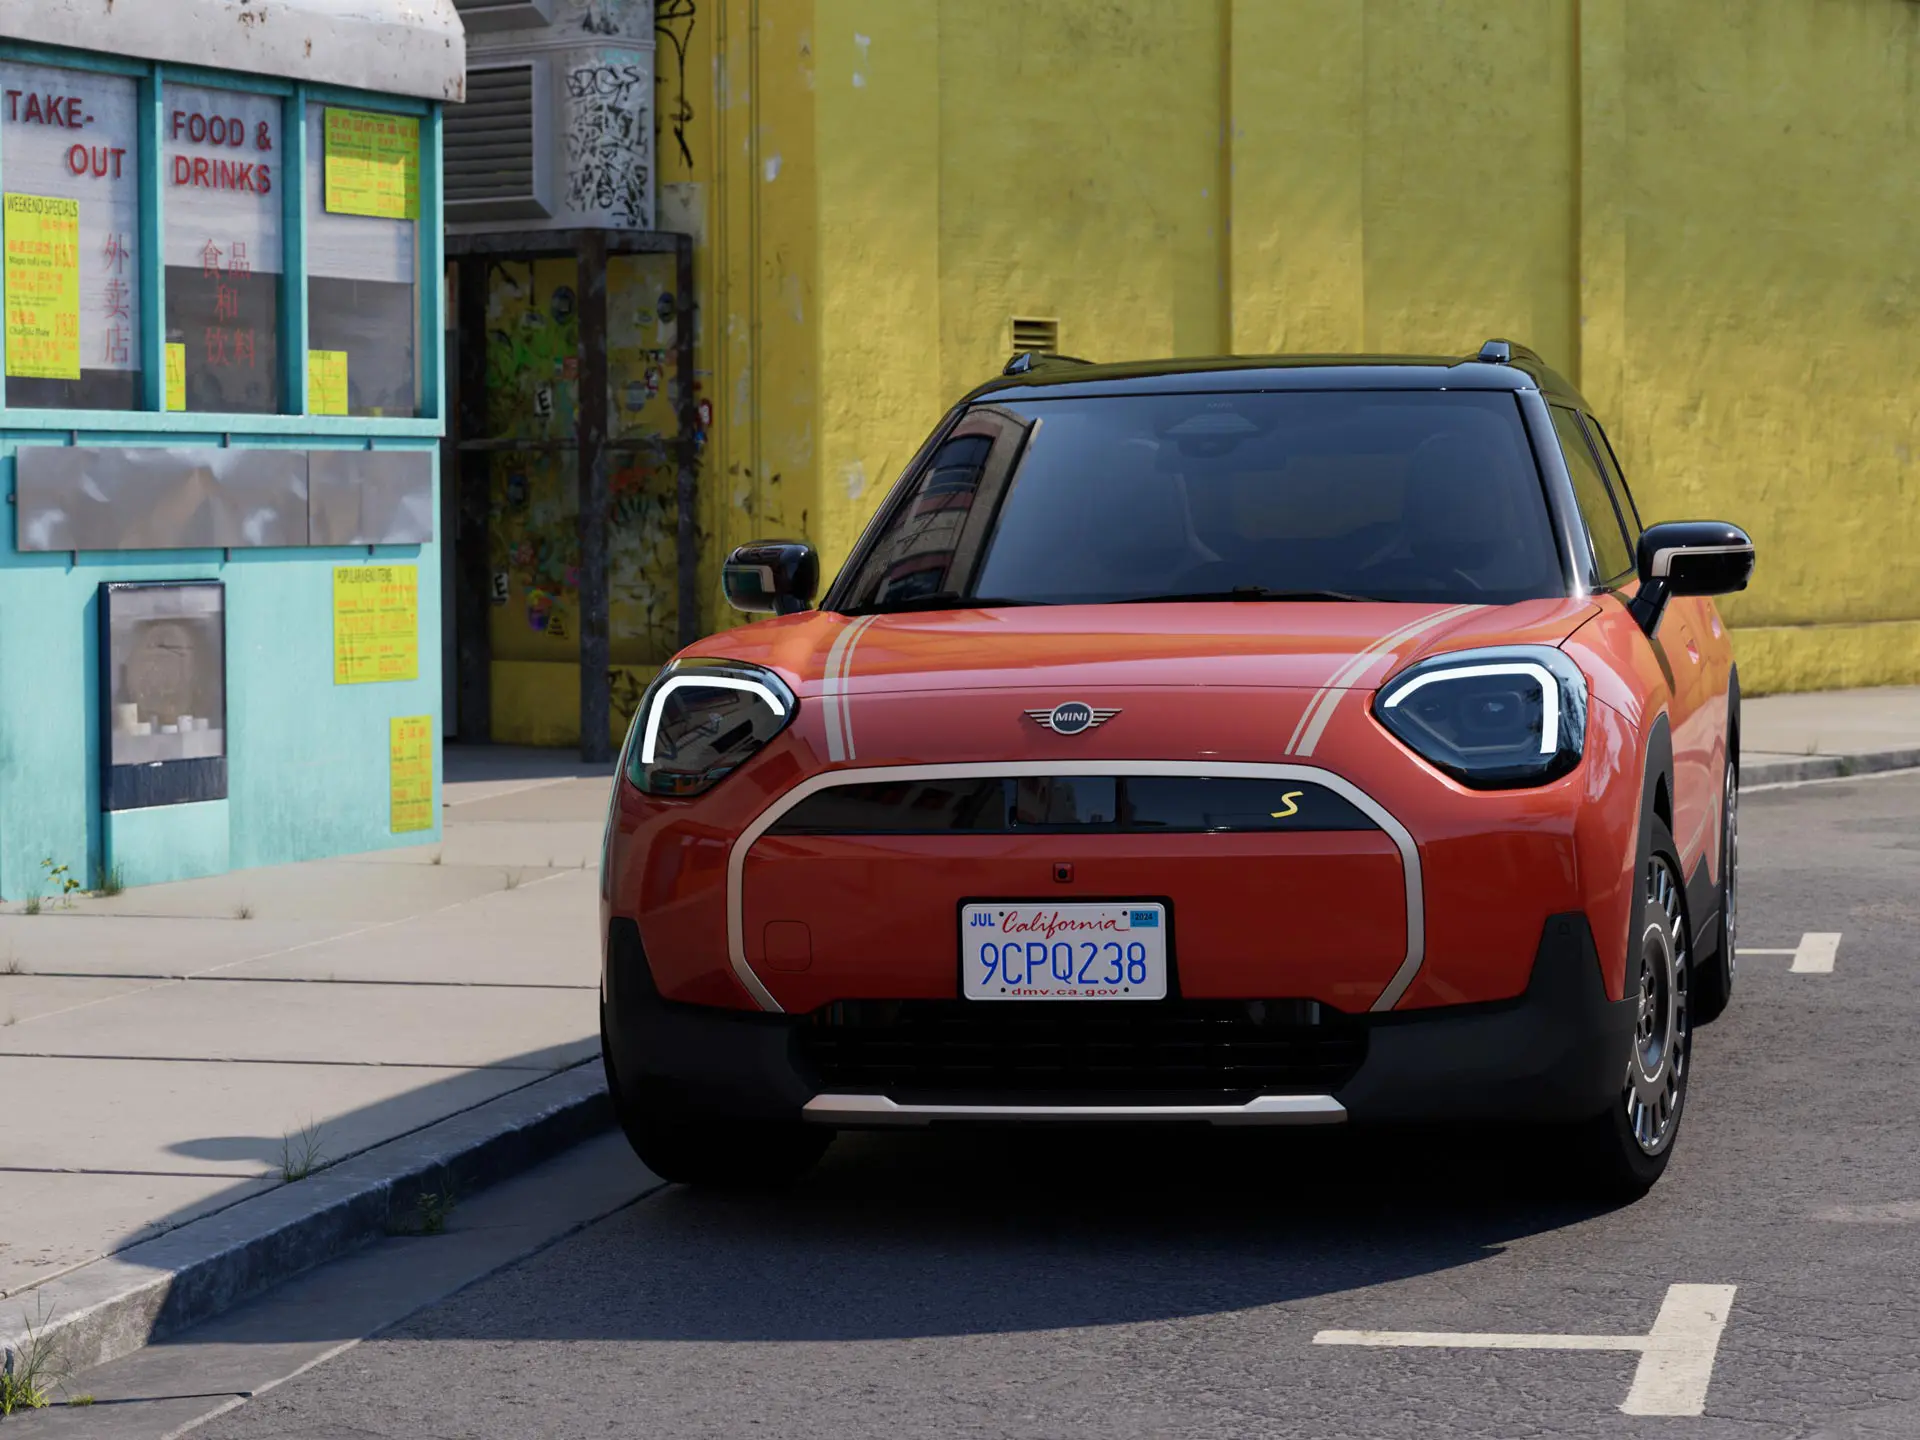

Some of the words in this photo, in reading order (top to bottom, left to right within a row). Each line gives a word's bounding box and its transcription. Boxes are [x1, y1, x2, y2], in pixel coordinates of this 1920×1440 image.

[6, 90, 94, 128] TAKE-
[172, 111, 245, 147] FOOD
[256, 121, 272, 150] &
[69, 144, 126, 179] OUT
[174, 155, 271, 194] DRINKS
[7, 196, 43, 214] WEEKEND
[45, 199, 78, 217] SPECIALS
[202, 239, 251, 280] 食品
[103, 233, 129, 365] 外卖店
[214, 284, 239, 321] 和
[205, 327, 256, 369] 饮料
[1055, 712, 1088, 721] MINI
[970, 913, 995, 927] JUL
[1002, 911, 1131, 939] California
[980, 942, 1147, 985] 9CPQ238
[1011, 987, 1119, 997] dmv.ca.gov
